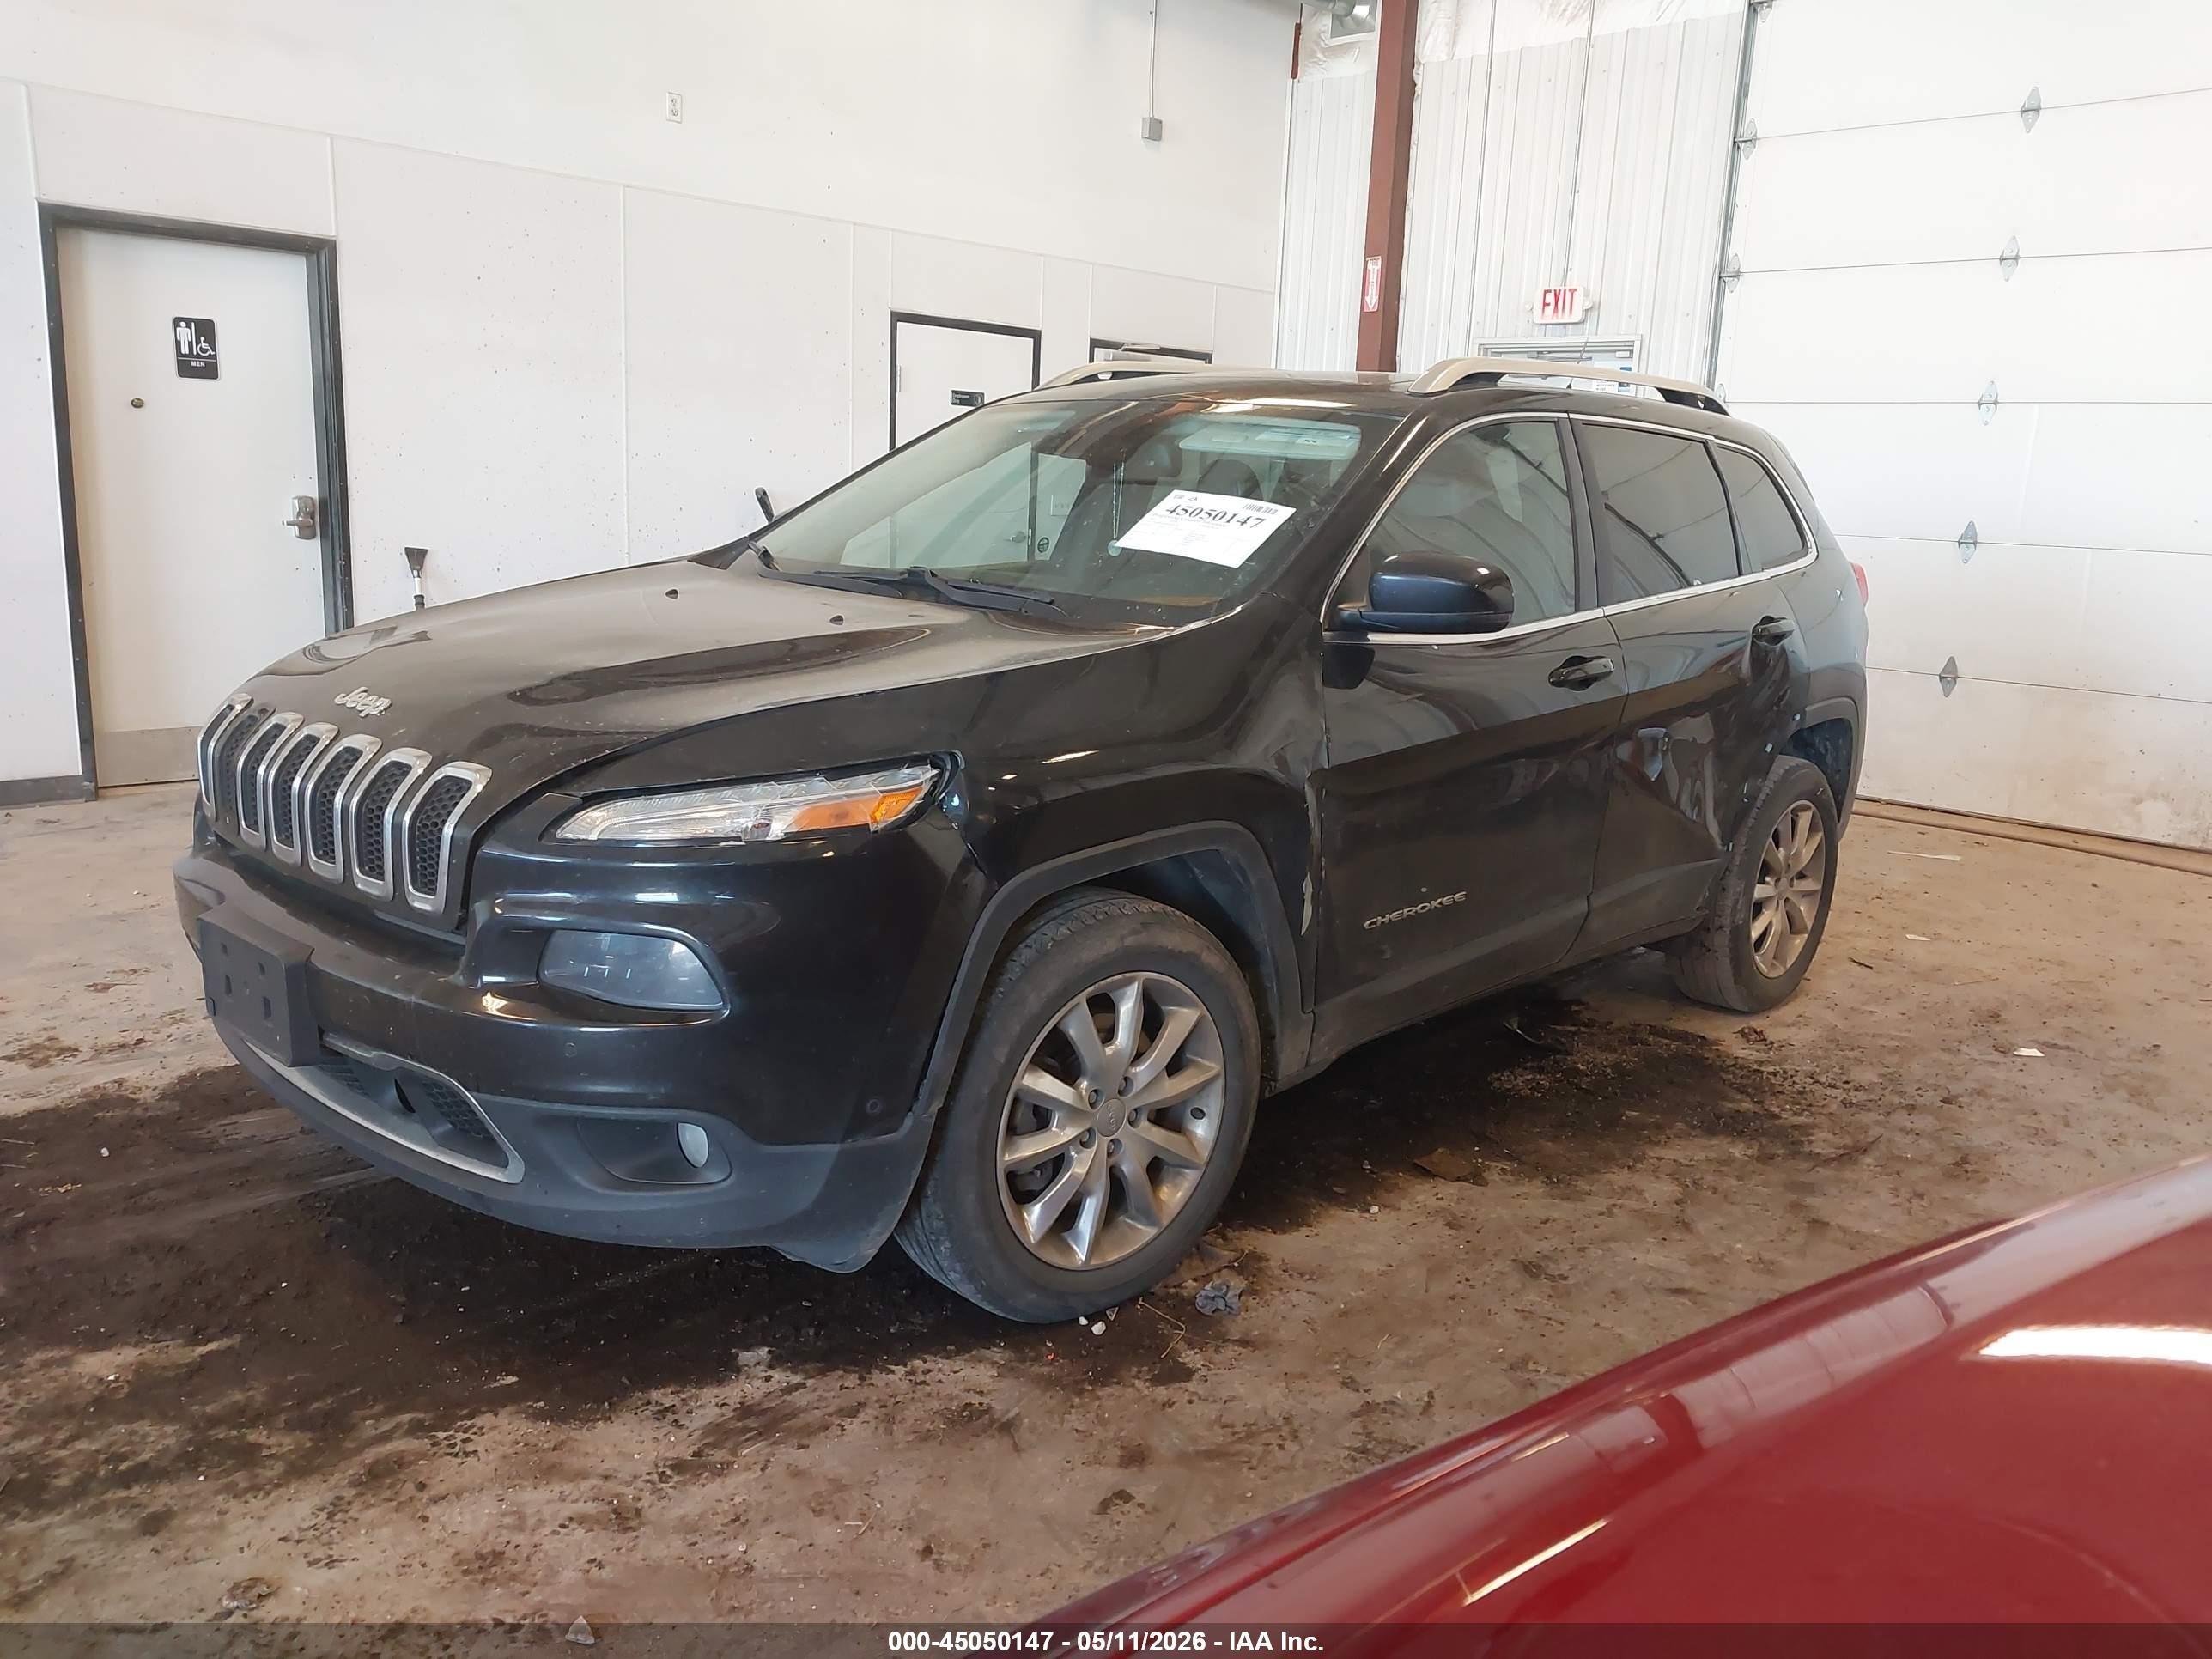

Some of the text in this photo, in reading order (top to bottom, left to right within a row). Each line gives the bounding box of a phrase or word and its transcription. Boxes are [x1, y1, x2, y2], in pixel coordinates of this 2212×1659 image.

[1541, 288, 1577, 319] EXIT
[1165, 504, 1267, 529] 45050147
[334, 686, 392, 717] Jeep
[1363, 891, 1467, 929] CHEROKEE
